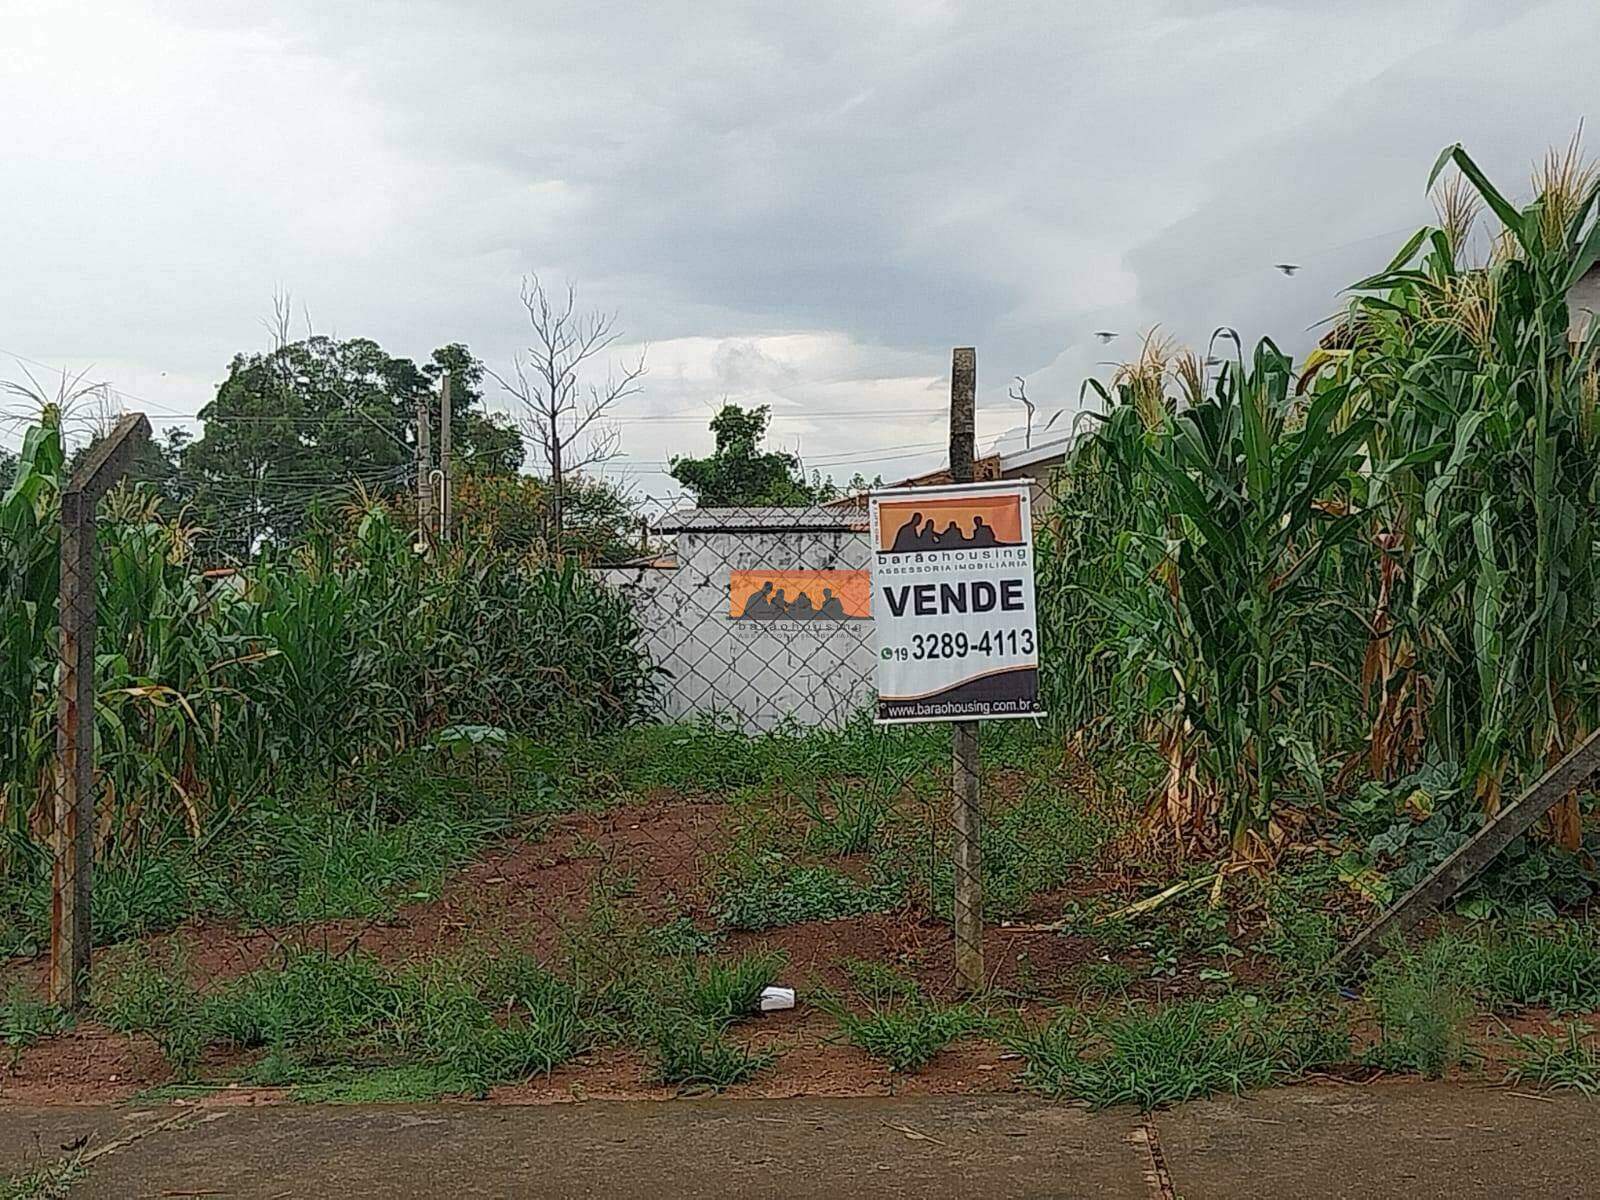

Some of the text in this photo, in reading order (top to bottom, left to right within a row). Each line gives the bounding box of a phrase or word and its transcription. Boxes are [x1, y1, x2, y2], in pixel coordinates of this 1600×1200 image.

[883, 579, 1025, 617] VENDE
[894, 628, 1035, 661] 19 3289-4113
[888, 698, 1031, 717] www.baraohousing.com.br
